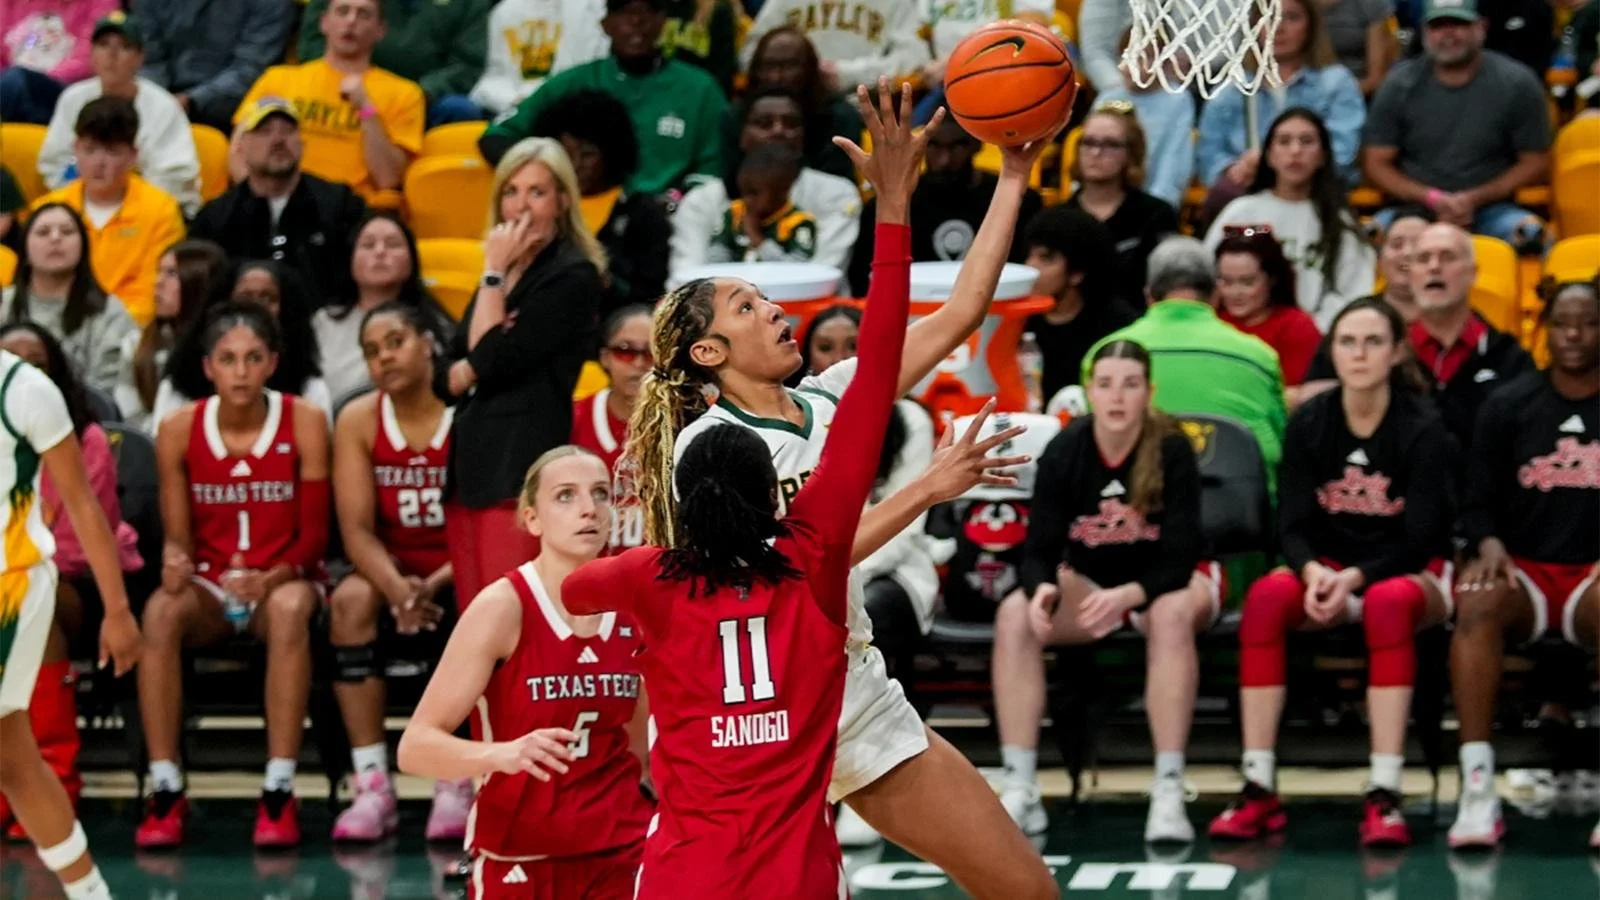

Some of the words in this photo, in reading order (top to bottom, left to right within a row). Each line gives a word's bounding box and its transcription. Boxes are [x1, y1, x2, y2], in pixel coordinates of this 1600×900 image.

[192, 483, 248, 504] TEXAS
[249, 480, 294, 502] TECH
[397, 488, 446, 528] 23
[237, 509, 251, 552] 1
[719, 616, 776, 704] 11
[526, 675, 596, 701] TEXAS
[566, 711, 600, 758] 5
[711, 709, 790, 748] SANOGO
